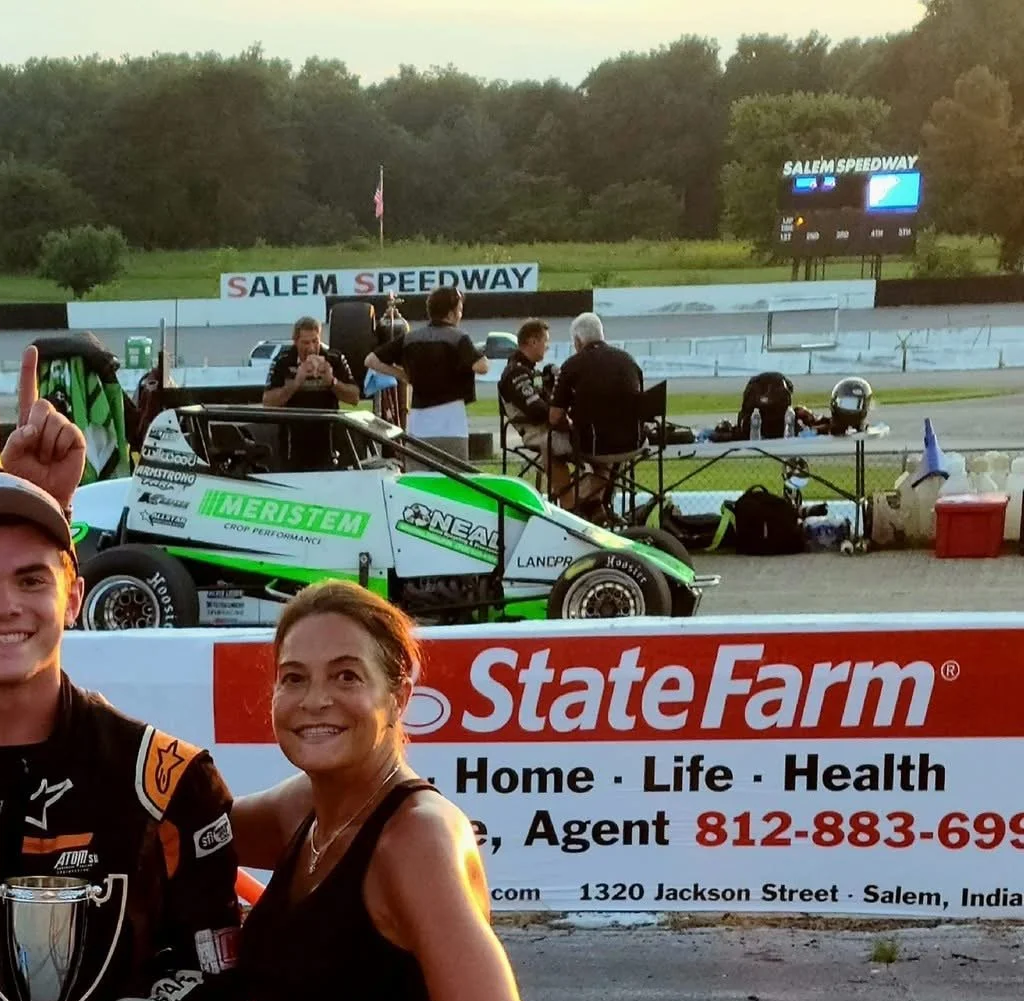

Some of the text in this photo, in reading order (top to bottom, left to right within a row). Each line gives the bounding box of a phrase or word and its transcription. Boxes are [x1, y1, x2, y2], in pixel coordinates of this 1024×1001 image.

[782, 154, 919, 176] SALEM SPEEDWAY
[227, 266, 533, 298] SALEM SPEEDWAY
[135, 464, 196, 485] ARMSTRONG
[219, 494, 364, 535] MERISTEM
[223, 522, 251, 534] CROP
[517, 555, 576, 569] LANDPR
[456, 753, 946, 793] Home Life Health
[524, 810, 670, 854] Agent
[579, 883, 644, 901] 1320
[654, 883, 751, 901] Jackson
[761, 883, 839, 902] Street
[863, 884, 950, 910] Salem,
